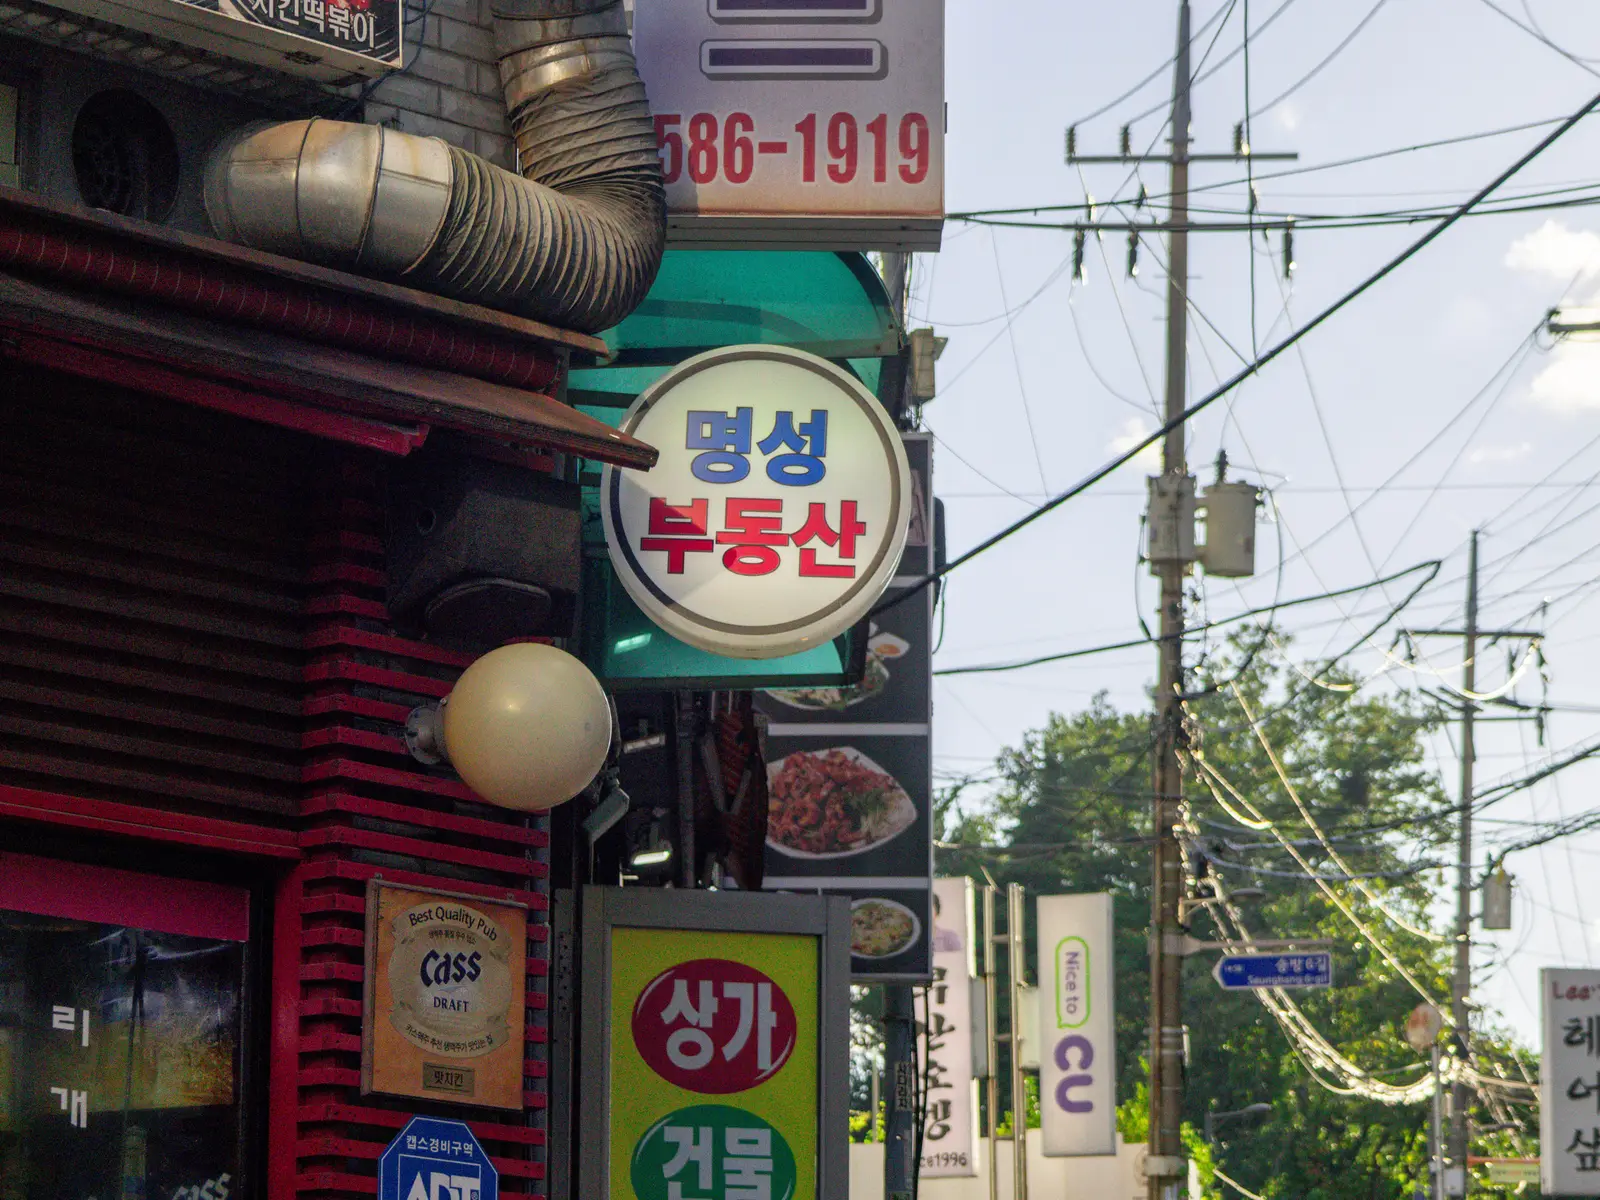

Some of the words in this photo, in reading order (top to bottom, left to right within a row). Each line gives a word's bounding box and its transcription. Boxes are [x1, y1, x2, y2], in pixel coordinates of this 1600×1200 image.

[653, 112, 930, 184] 586-1919
[686, 406, 828, 487] 명성
[640, 497, 867, 579] 부동산
[409, 909, 433, 926] Best
[435, 906, 475, 928] Quality
[477, 920, 498, 941] Pub
[420, 949, 482, 987] Cass
[1065, 951, 1080, 993] Nice
[433, 996, 470, 1013] DRAFT
[1065, 995, 1080, 1015] to
[1552, 980, 1600, 1001] Lee'
[660, 978, 778, 1071] 상가
[1054, 1034, 1094, 1114] CU
[406, 1135, 474, 1157] 캡스경비구역
[662, 1126, 773, 1200] 건물
[406, 1171, 481, 1200] ADT
